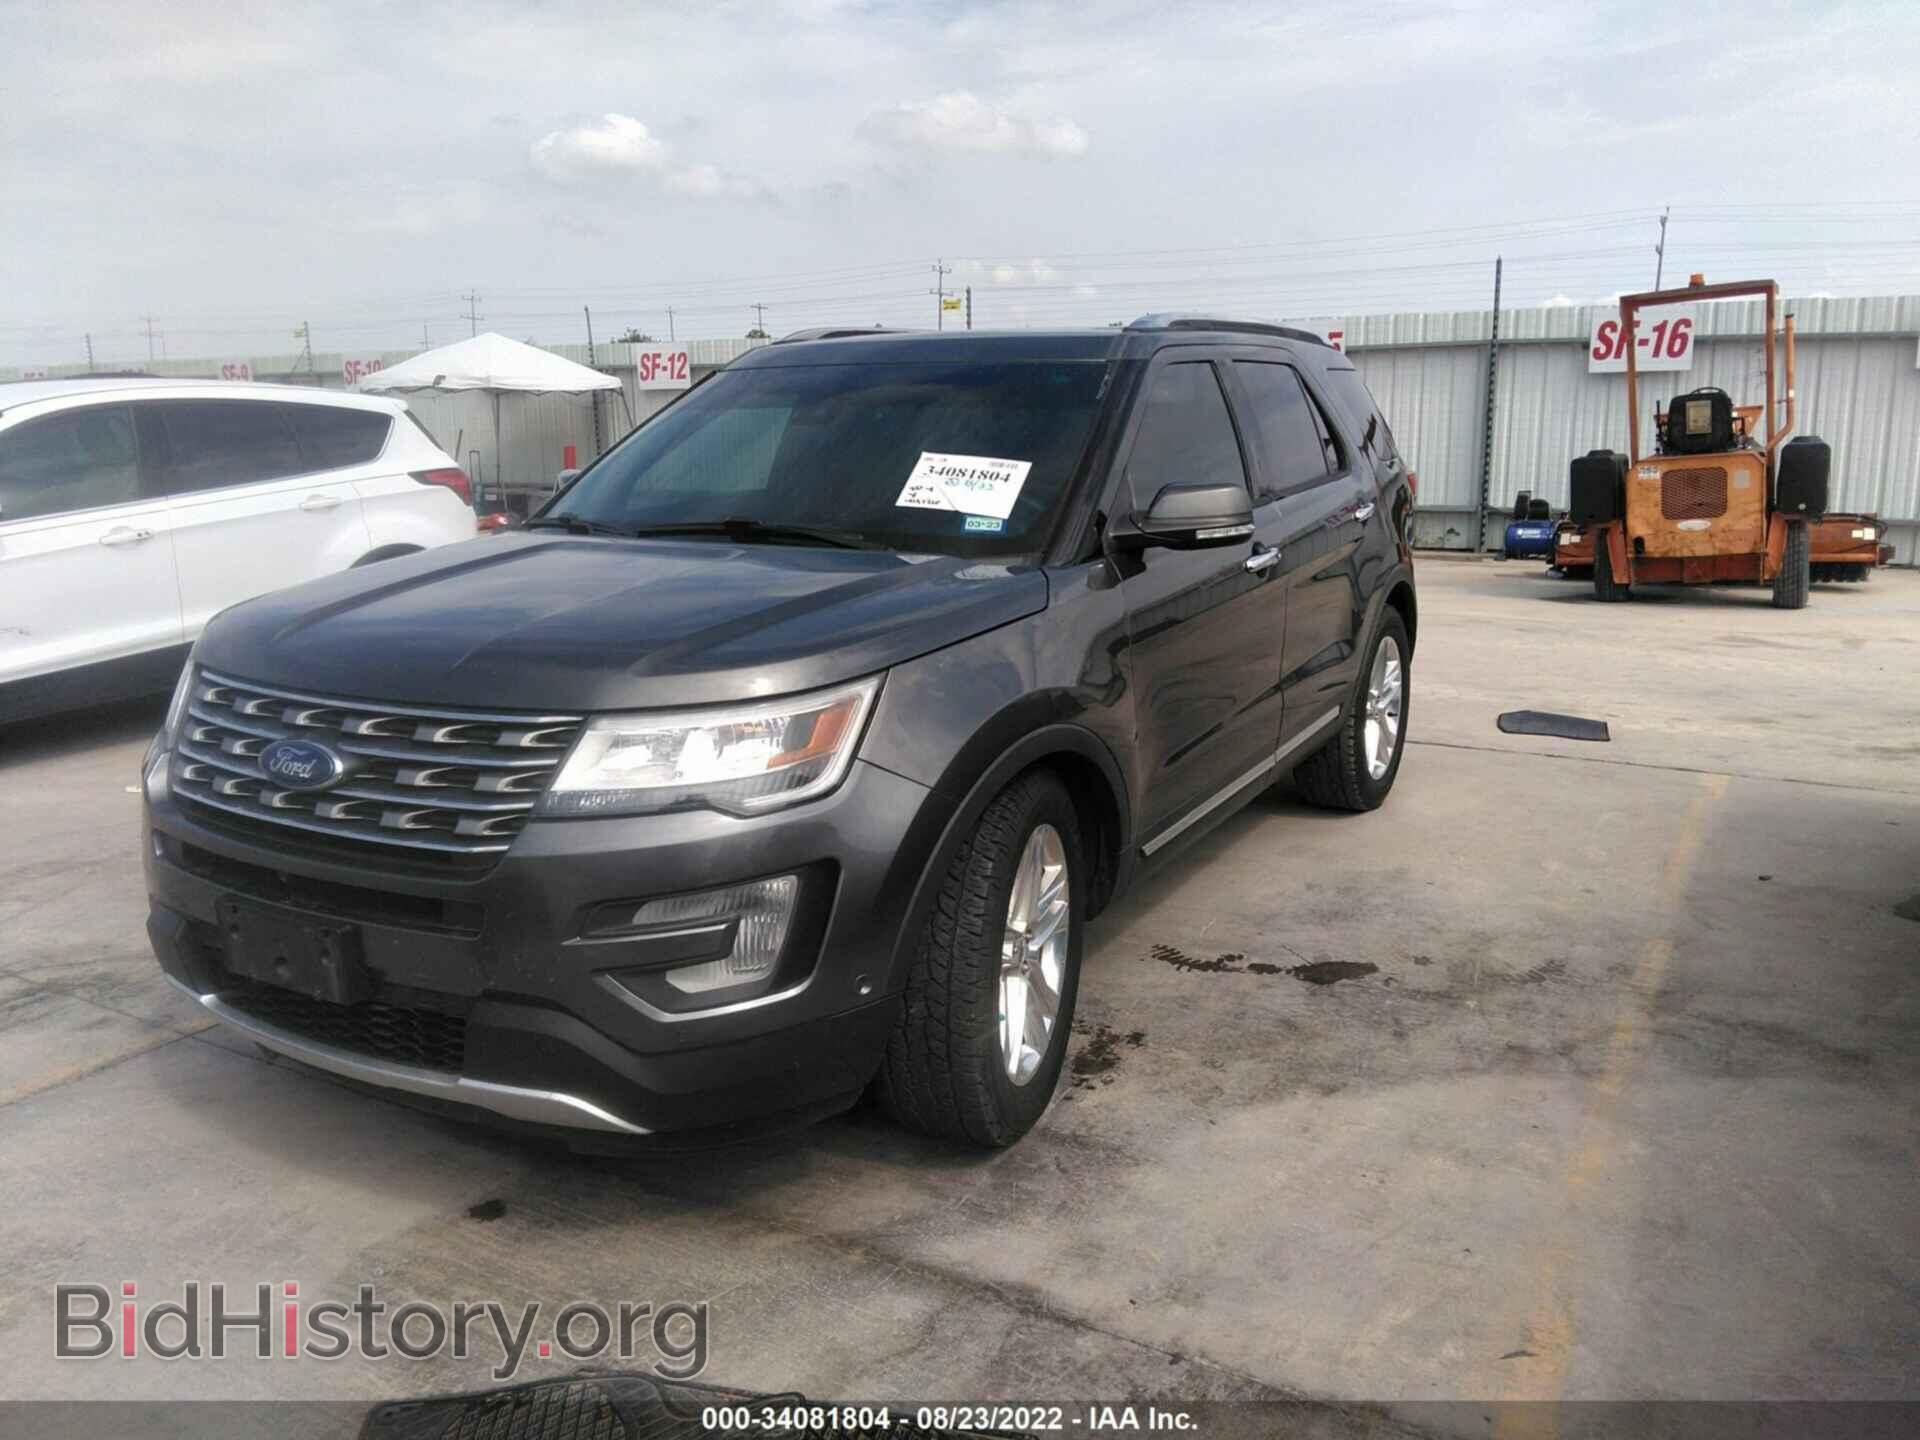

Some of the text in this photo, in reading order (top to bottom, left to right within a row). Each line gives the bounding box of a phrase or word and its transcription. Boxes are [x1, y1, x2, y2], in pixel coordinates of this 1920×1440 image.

[640, 351, 687, 381] SF-12
[928, 465, 1012, 483] 34081804
[270, 746, 318, 778] Ford
